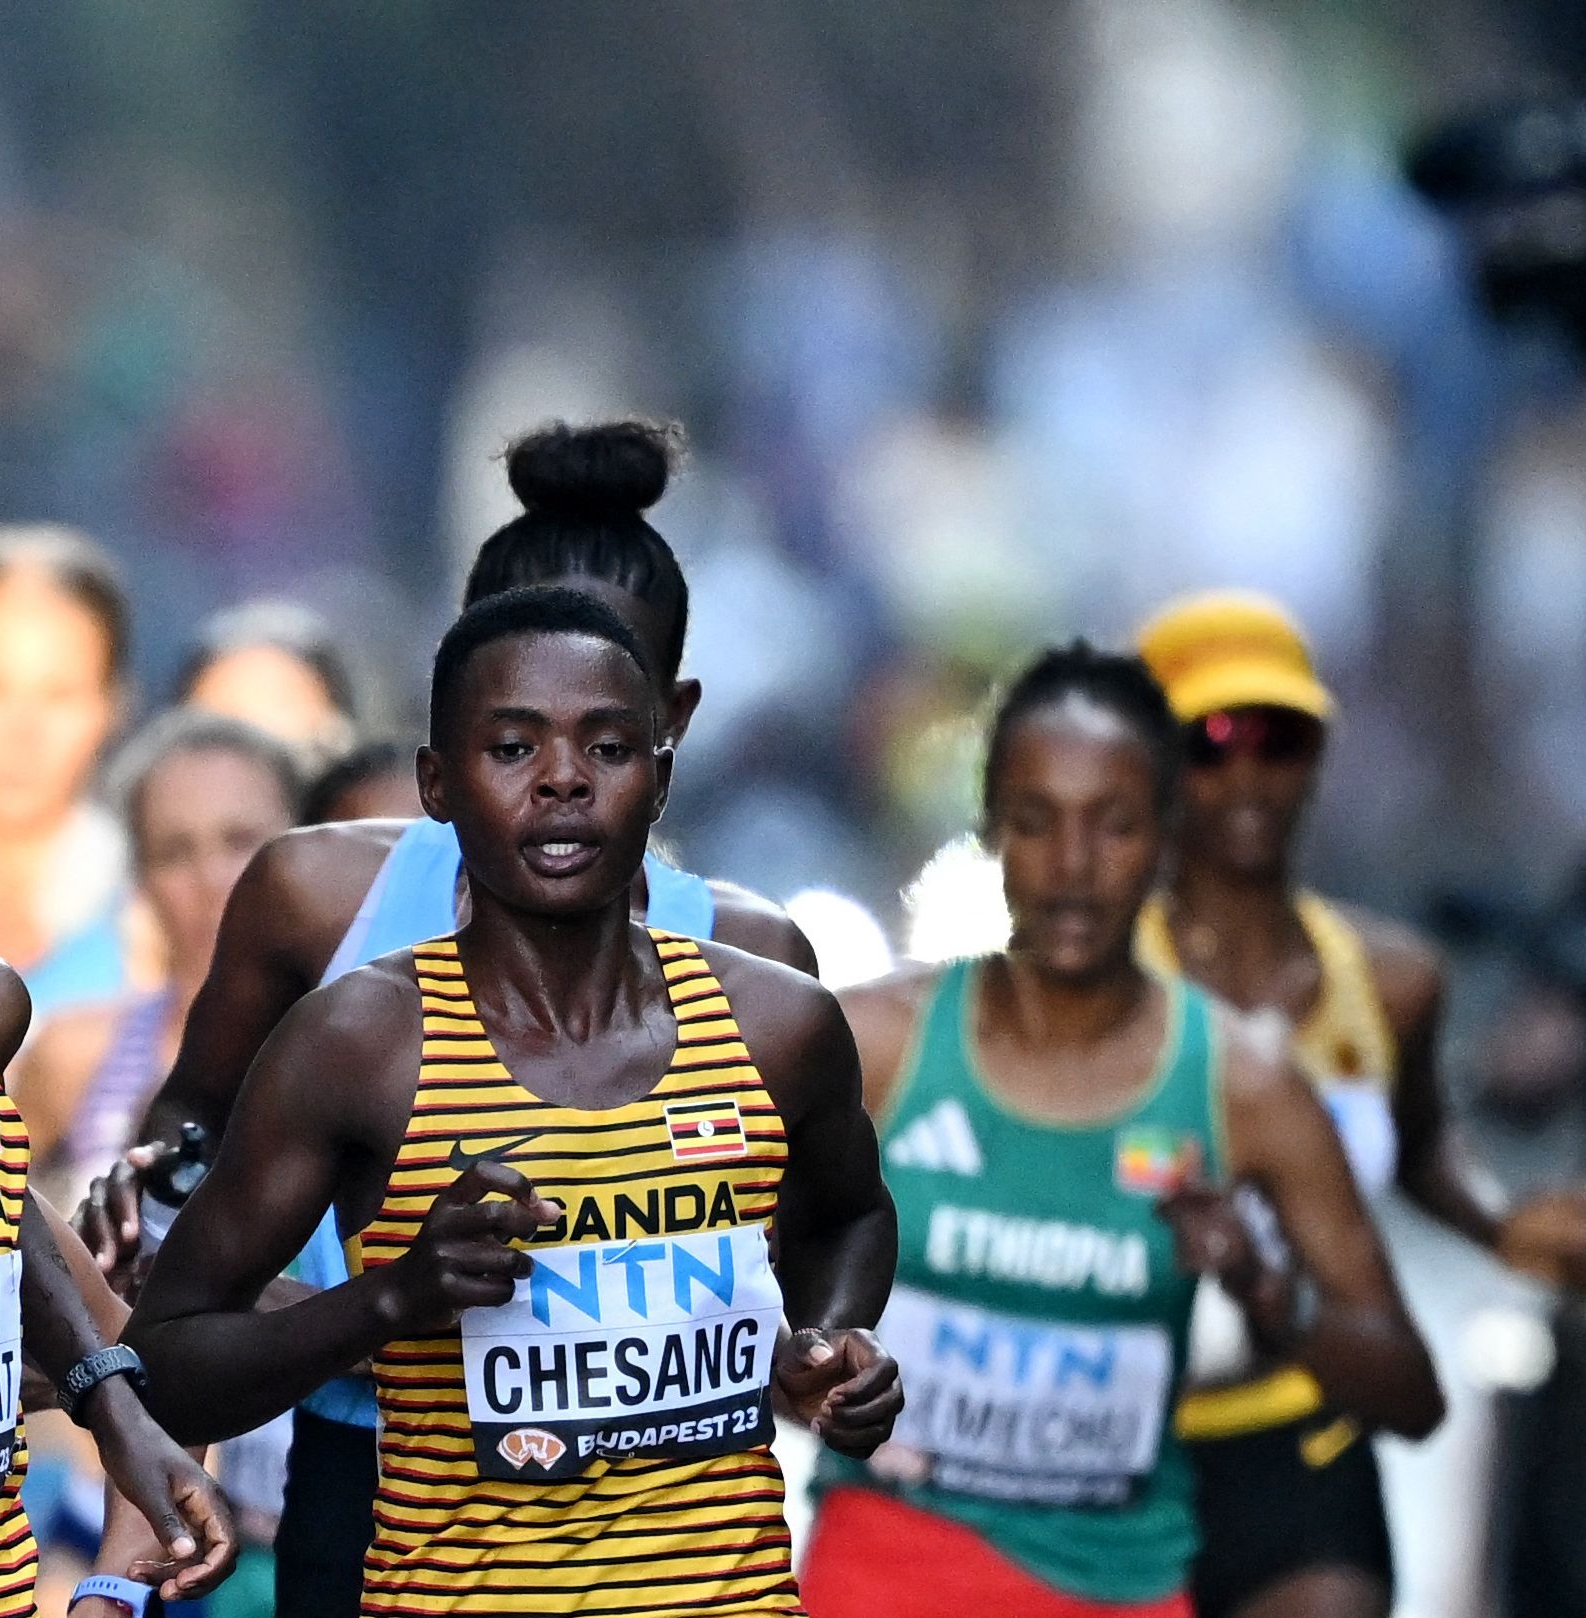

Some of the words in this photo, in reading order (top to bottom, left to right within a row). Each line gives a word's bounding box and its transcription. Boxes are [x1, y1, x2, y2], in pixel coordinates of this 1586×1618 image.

[527, 1181, 738, 1243] GANDA
[530, 1235, 735, 1329] NTN
[483, 1317, 759, 1415] CHESANG
[932, 1317, 1116, 1391] NTN
[576, 1416, 729, 1458] BUDAPEST
[731, 1406, 760, 1432] 23
